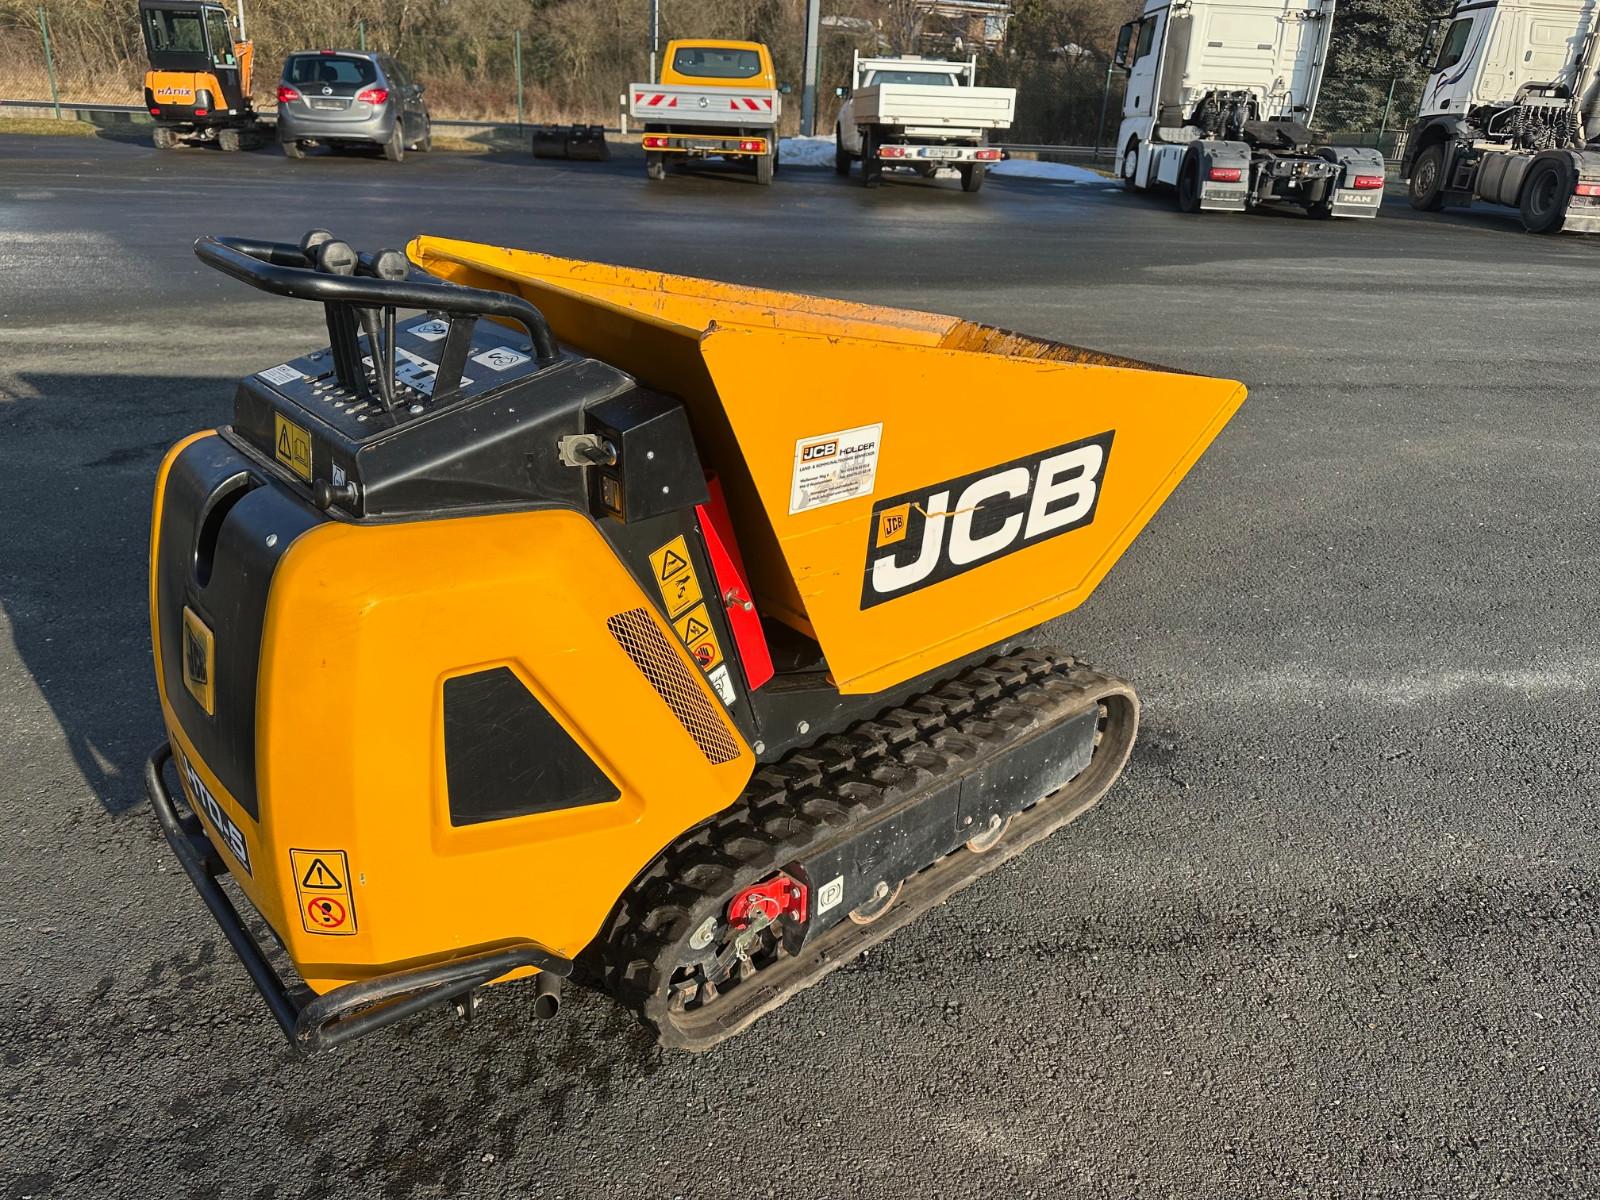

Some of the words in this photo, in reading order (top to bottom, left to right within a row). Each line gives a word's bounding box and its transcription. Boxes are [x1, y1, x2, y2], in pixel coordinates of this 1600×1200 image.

[158, 86, 191, 95] HANIX
[1344, 194, 1372, 203] MAN
[803, 443, 836, 459] JCB
[839, 442, 875, 456] HOLDER
[872, 444, 1103, 593] JCB
[886, 516, 903, 535] JCB
